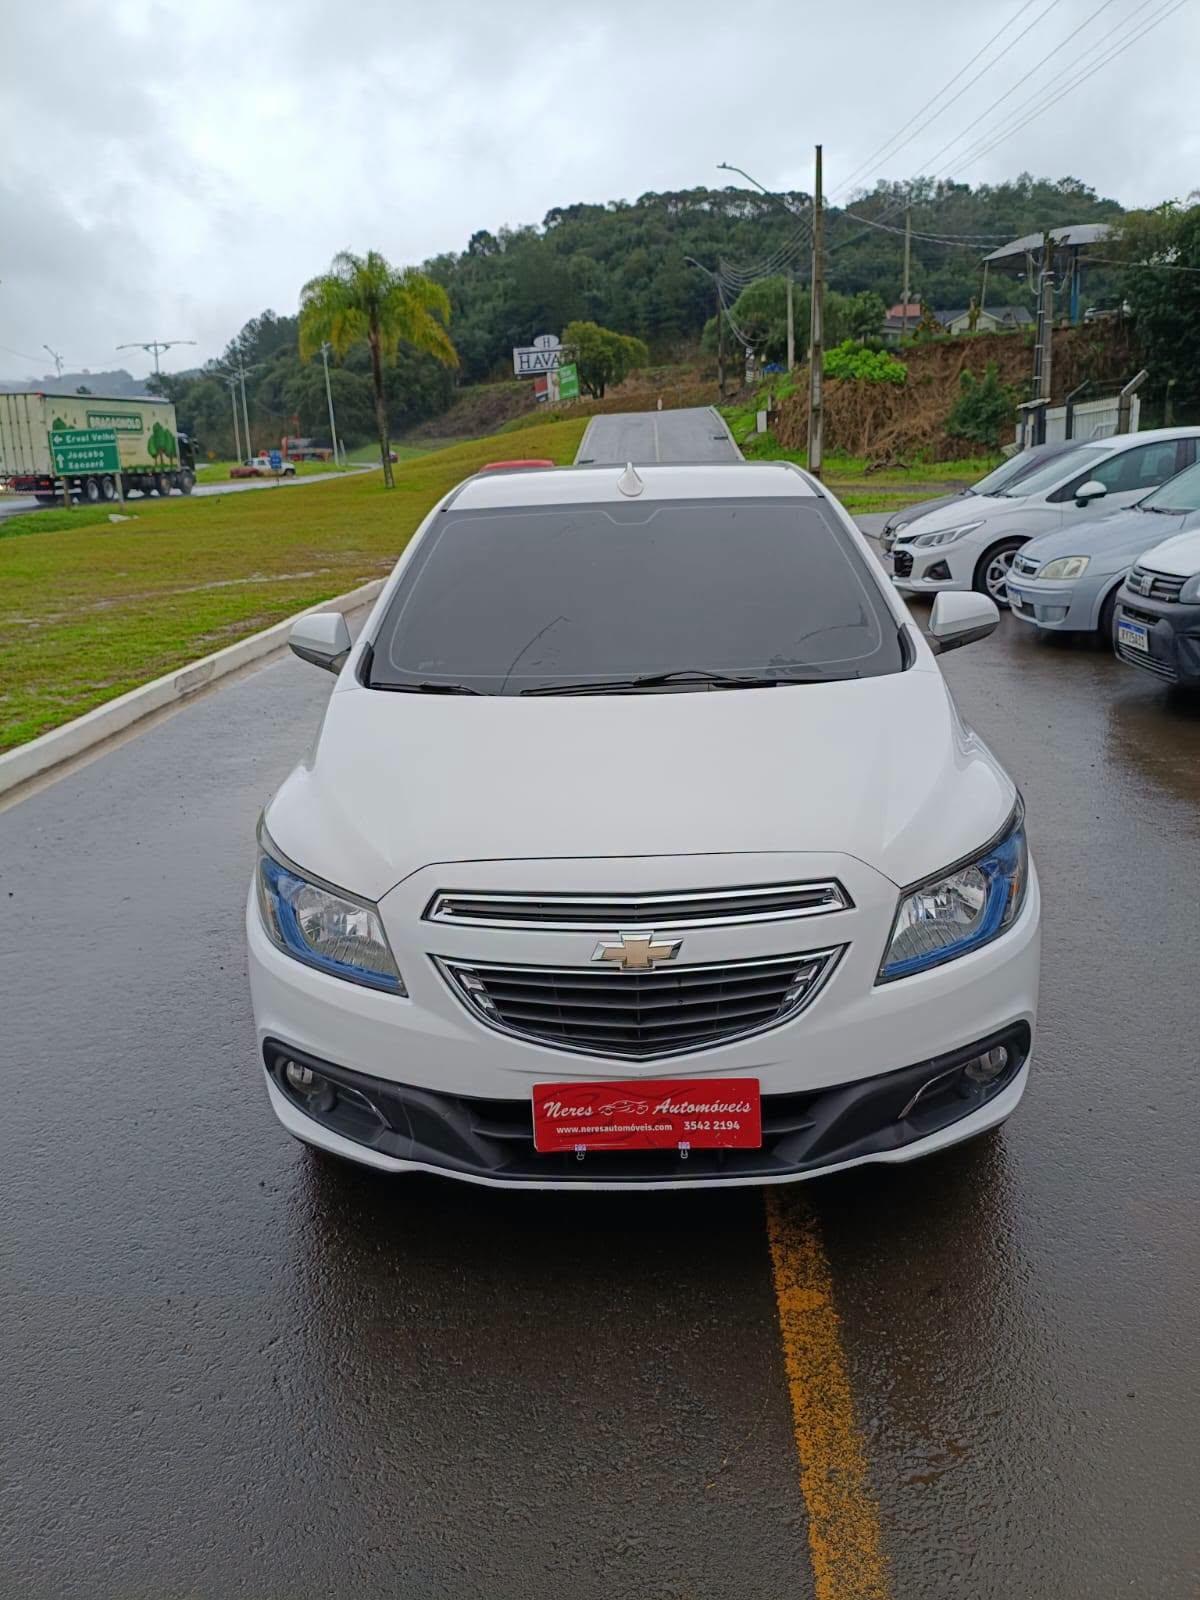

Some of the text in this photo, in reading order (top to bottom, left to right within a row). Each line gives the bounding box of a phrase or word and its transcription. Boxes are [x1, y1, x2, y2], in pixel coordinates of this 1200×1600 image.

[543, 337, 550, 348] H
[519, 352, 563, 369] HAVA
[65, 434, 90, 444] Erval
[92, 432, 115, 442] Velho
[543, 1097, 752, 1118] Neres Automóveis
[683, 1120, 710, 1131] 3542
[713, 1119, 740, 1131] 2194
